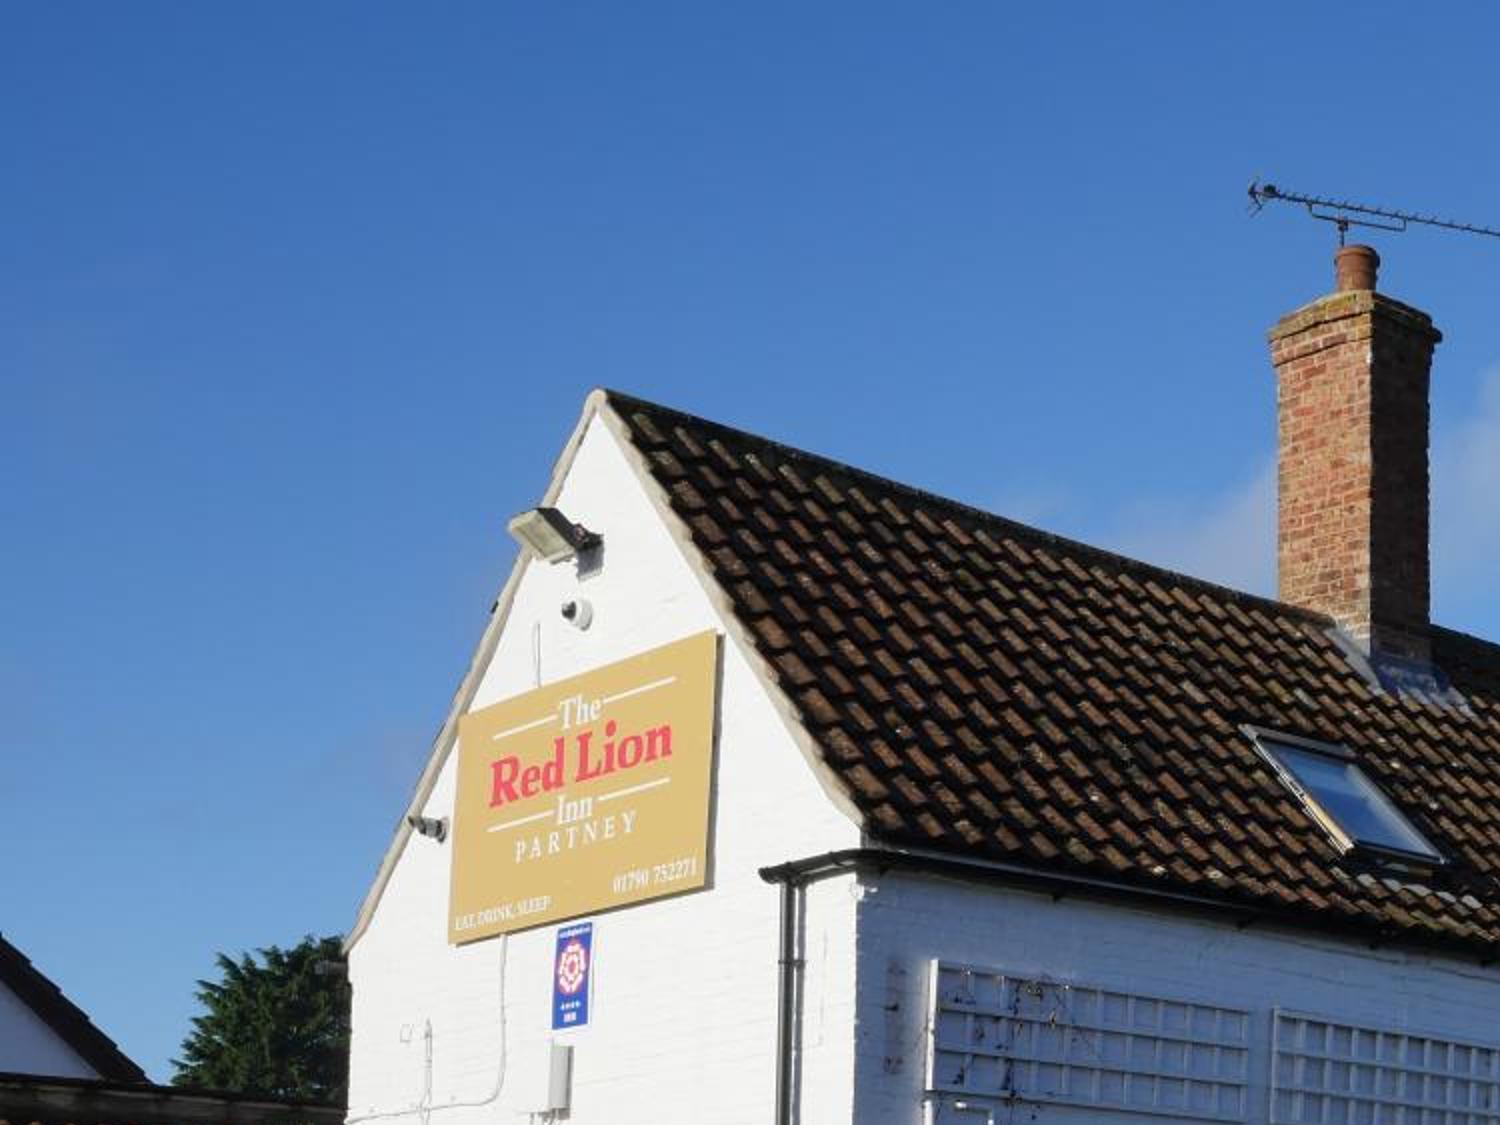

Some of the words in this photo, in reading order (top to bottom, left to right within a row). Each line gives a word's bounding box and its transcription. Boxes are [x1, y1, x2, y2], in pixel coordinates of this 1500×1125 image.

[559, 694, 602, 730] The
[489, 736, 565, 808] Red
[575, 719, 673, 783] Lion
[557, 795, 593, 825] Inn
[515, 810, 637, 864] PARTNEY
